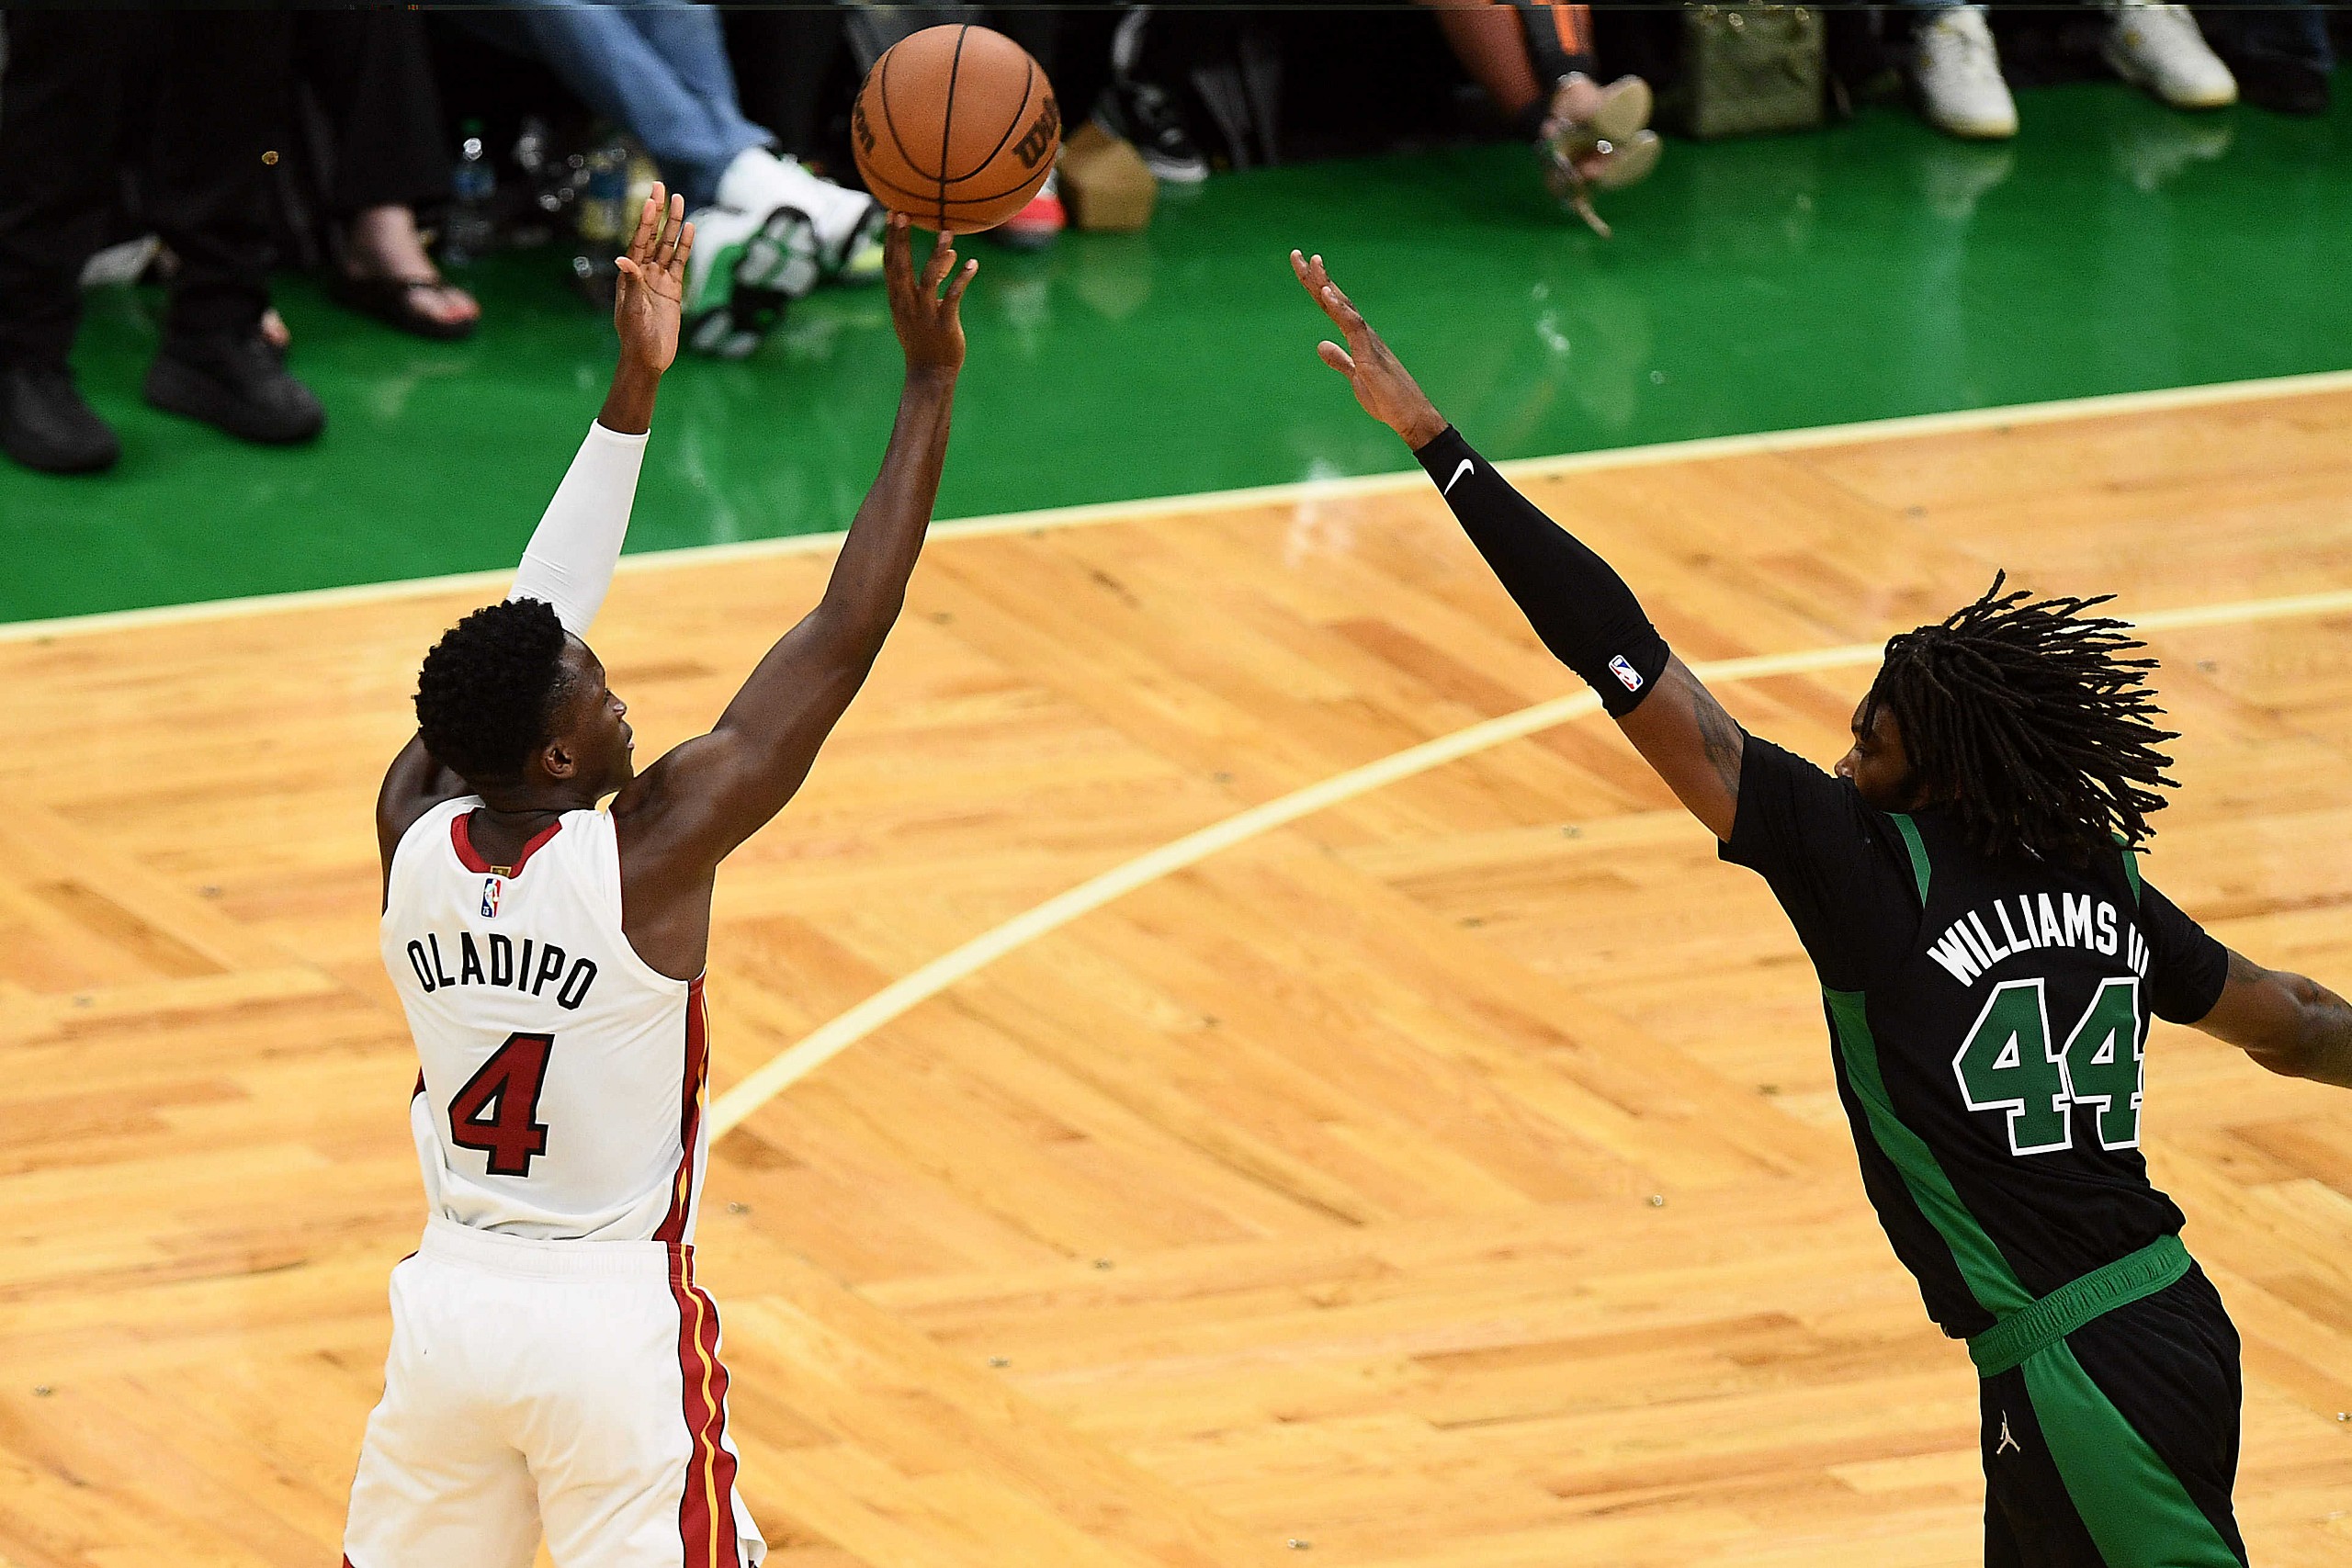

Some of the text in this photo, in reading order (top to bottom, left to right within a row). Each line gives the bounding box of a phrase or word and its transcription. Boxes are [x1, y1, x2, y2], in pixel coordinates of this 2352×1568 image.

[407, 931, 598, 1010] OLADIPO
[1927, 893, 2150, 987] WILLIAMS III
[447, 1032, 555, 1178] 4
[1952, 976, 2144, 1156] 44
